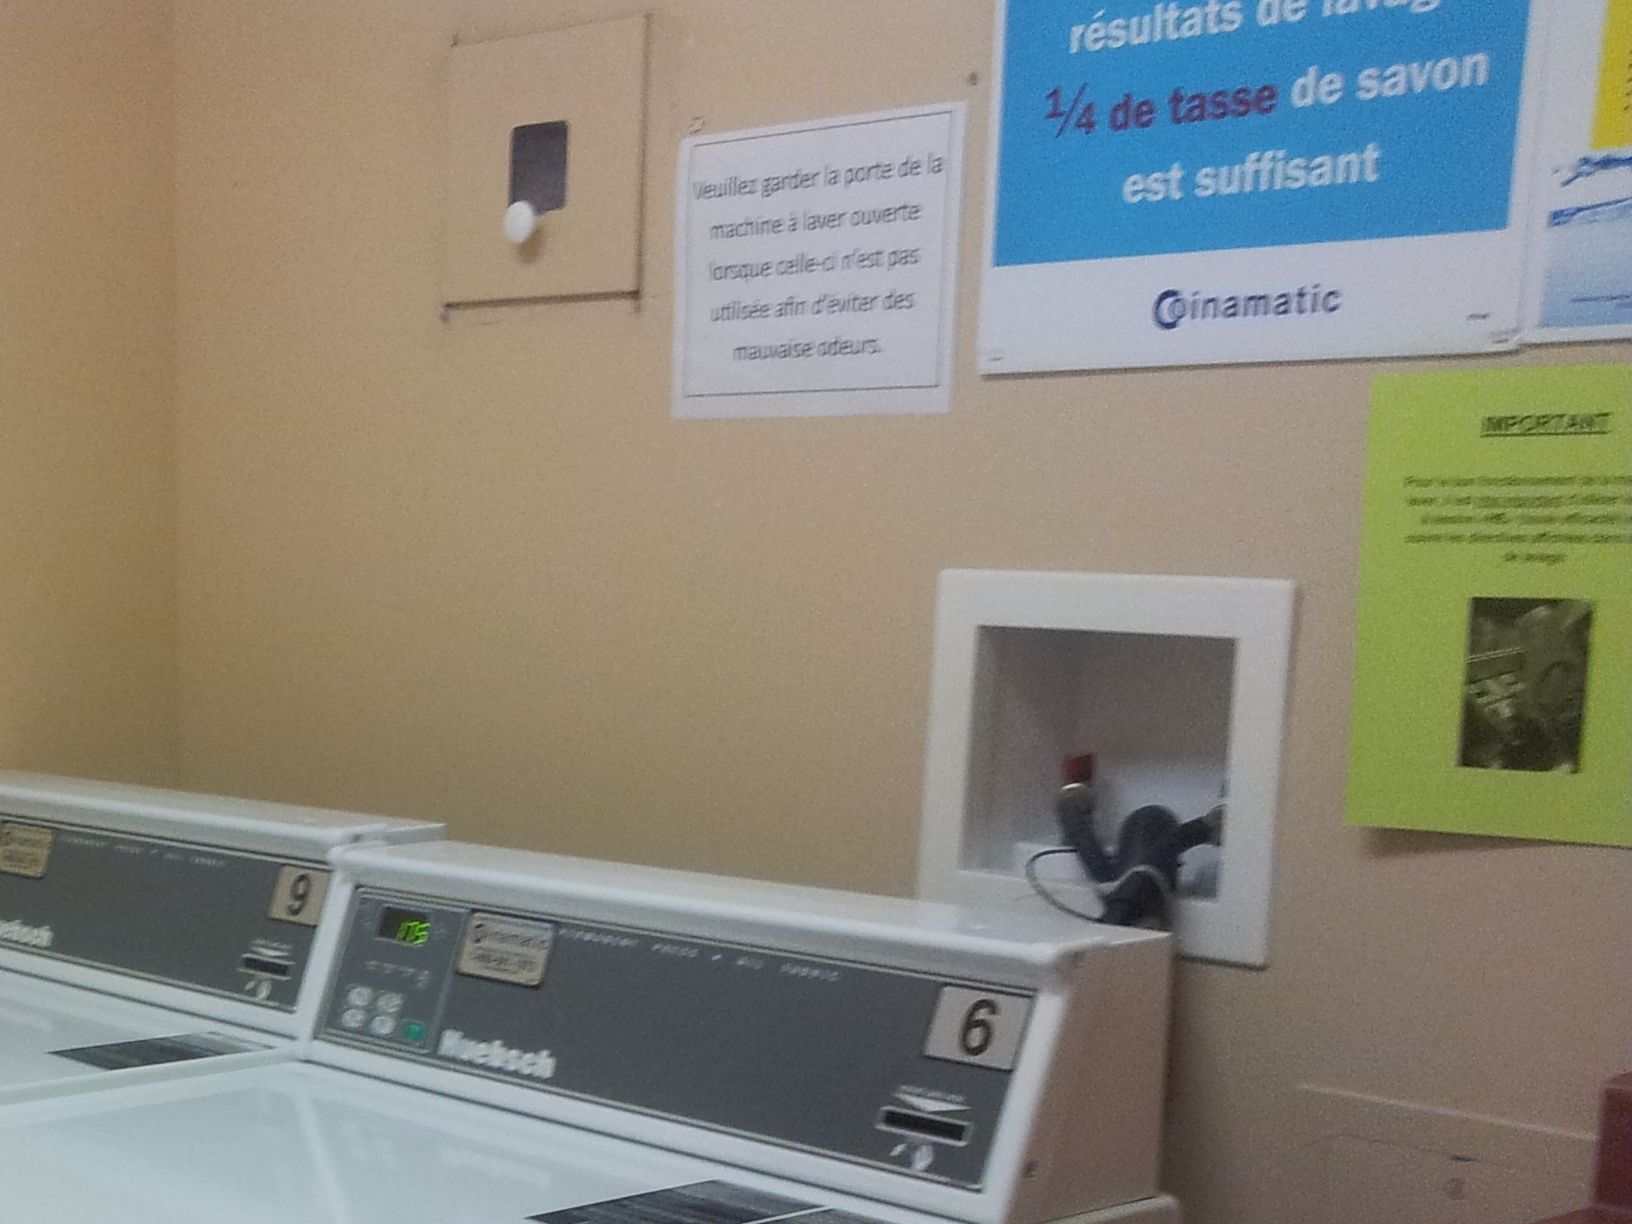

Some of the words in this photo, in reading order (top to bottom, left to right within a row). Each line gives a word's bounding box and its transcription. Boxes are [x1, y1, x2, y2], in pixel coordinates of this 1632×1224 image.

[1069, 1, 1244, 54] résultats
[1108, 92, 1154, 132] de
[1168, 83, 1279, 126] tasse
[1290, 65, 1344, 109] de
[1356, 50, 1489, 101] savon
[692, 178, 757, 200] Veuillez
[760, 168, 820, 199] garder
[824, 165, 842, 186] la
[844, 161, 894, 186] porte
[897, 156, 921, 178] de
[926, 153, 944, 174] la
[1122, 167, 1183, 204] est
[1195, 144, 1381, 198] suffisant
[710, 217, 783, 239] machine
[787, 213, 799, 232] à
[803, 210, 847, 231] laver
[850, 202, 922, 225] ouverte
[708, 260, 772, 284] lorsque
[775, 252, 835, 277] celle-ci
[841, 248, 884, 269] n'est
[887, 247, 921, 271] pas
[710, 298, 769, 322] utilisée
[774, 296, 805, 318] afin
[811, 291, 878, 316] d'éviter
[882, 289, 915, 311] des
[1153, 283, 1343, 330] Coinamatic
[732, 340, 813, 361] mauvaise
[287, 872, 311, 916] 9
[958, 998, 1001, 1057] 6
